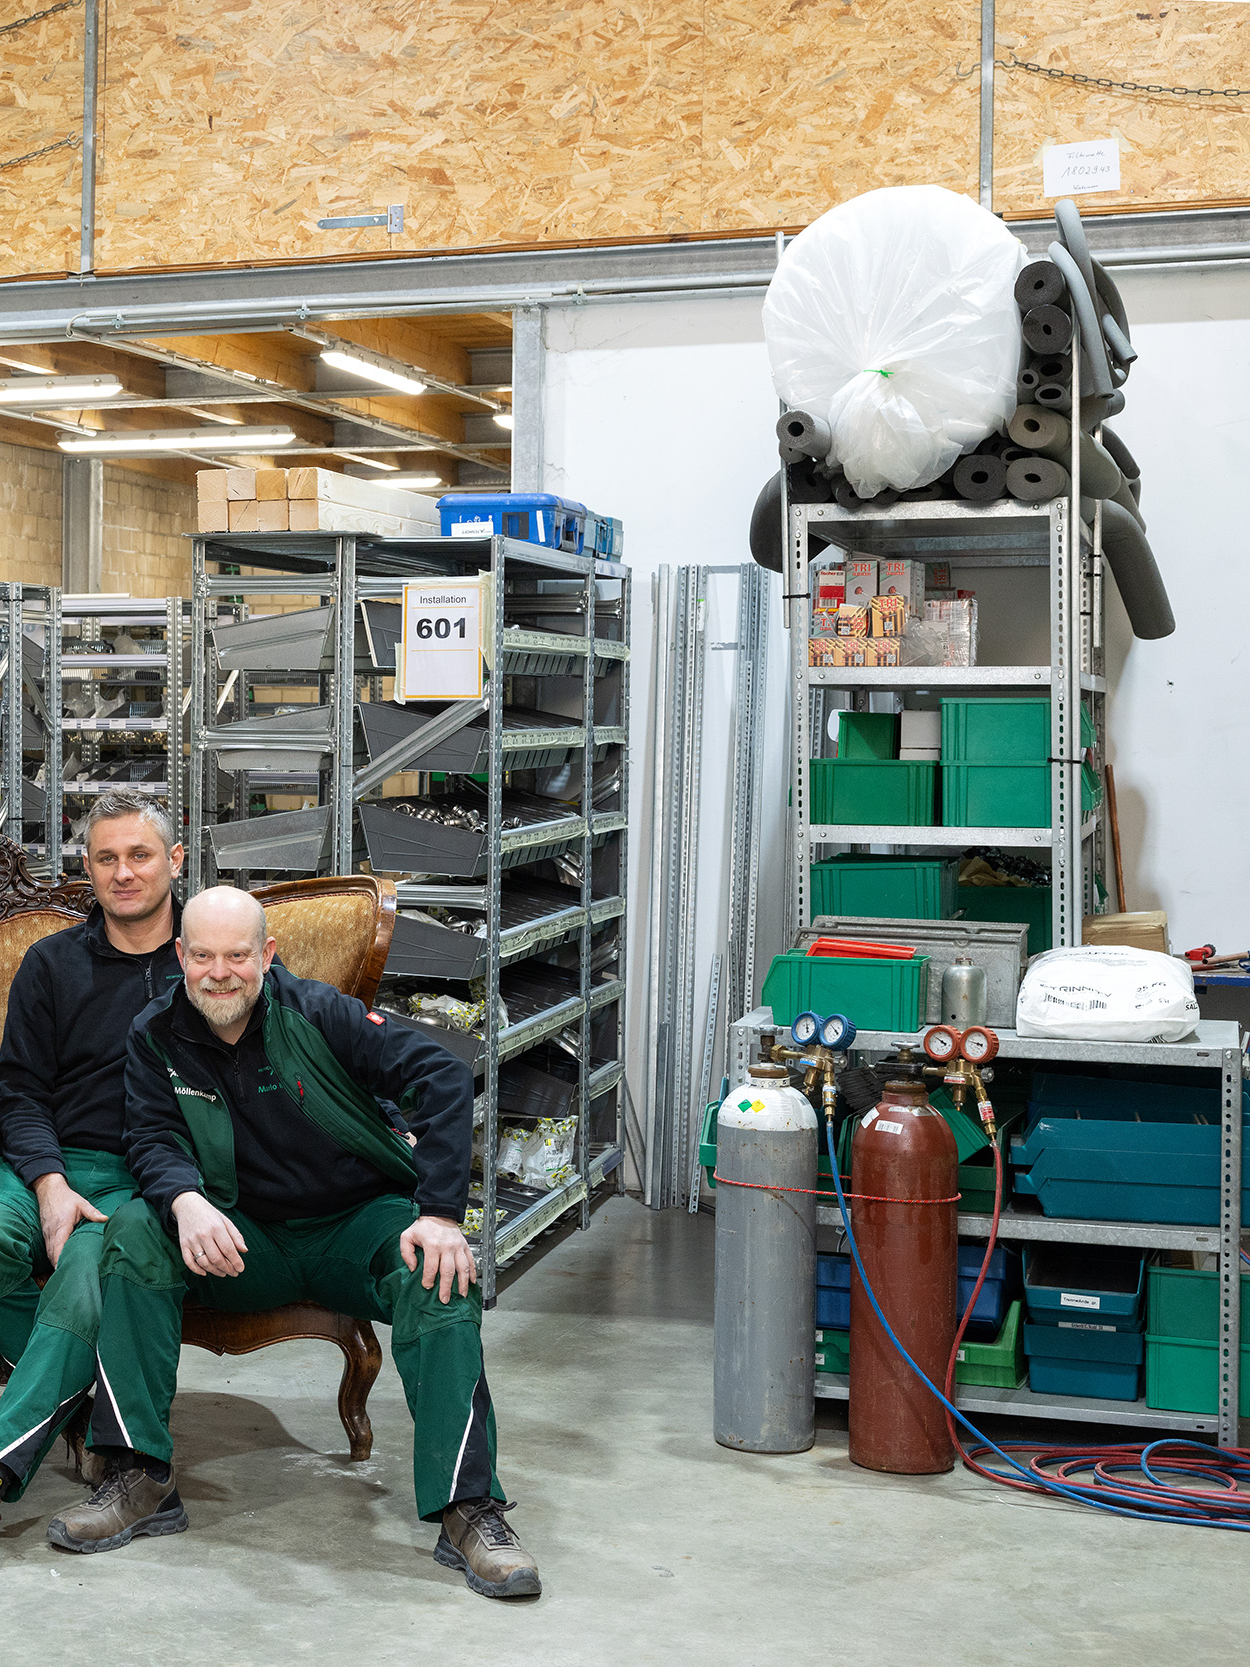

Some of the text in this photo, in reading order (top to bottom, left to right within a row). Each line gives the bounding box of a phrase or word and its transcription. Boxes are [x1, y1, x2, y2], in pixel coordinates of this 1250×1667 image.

[1060, 166, 1110, 178] 1802943
[853, 563, 871, 572] TRI
[886, 562, 905, 571] TRI
[419, 595, 467, 604] Installation
[879, 598, 897, 607] TRI
[416, 617, 466, 639] 601
